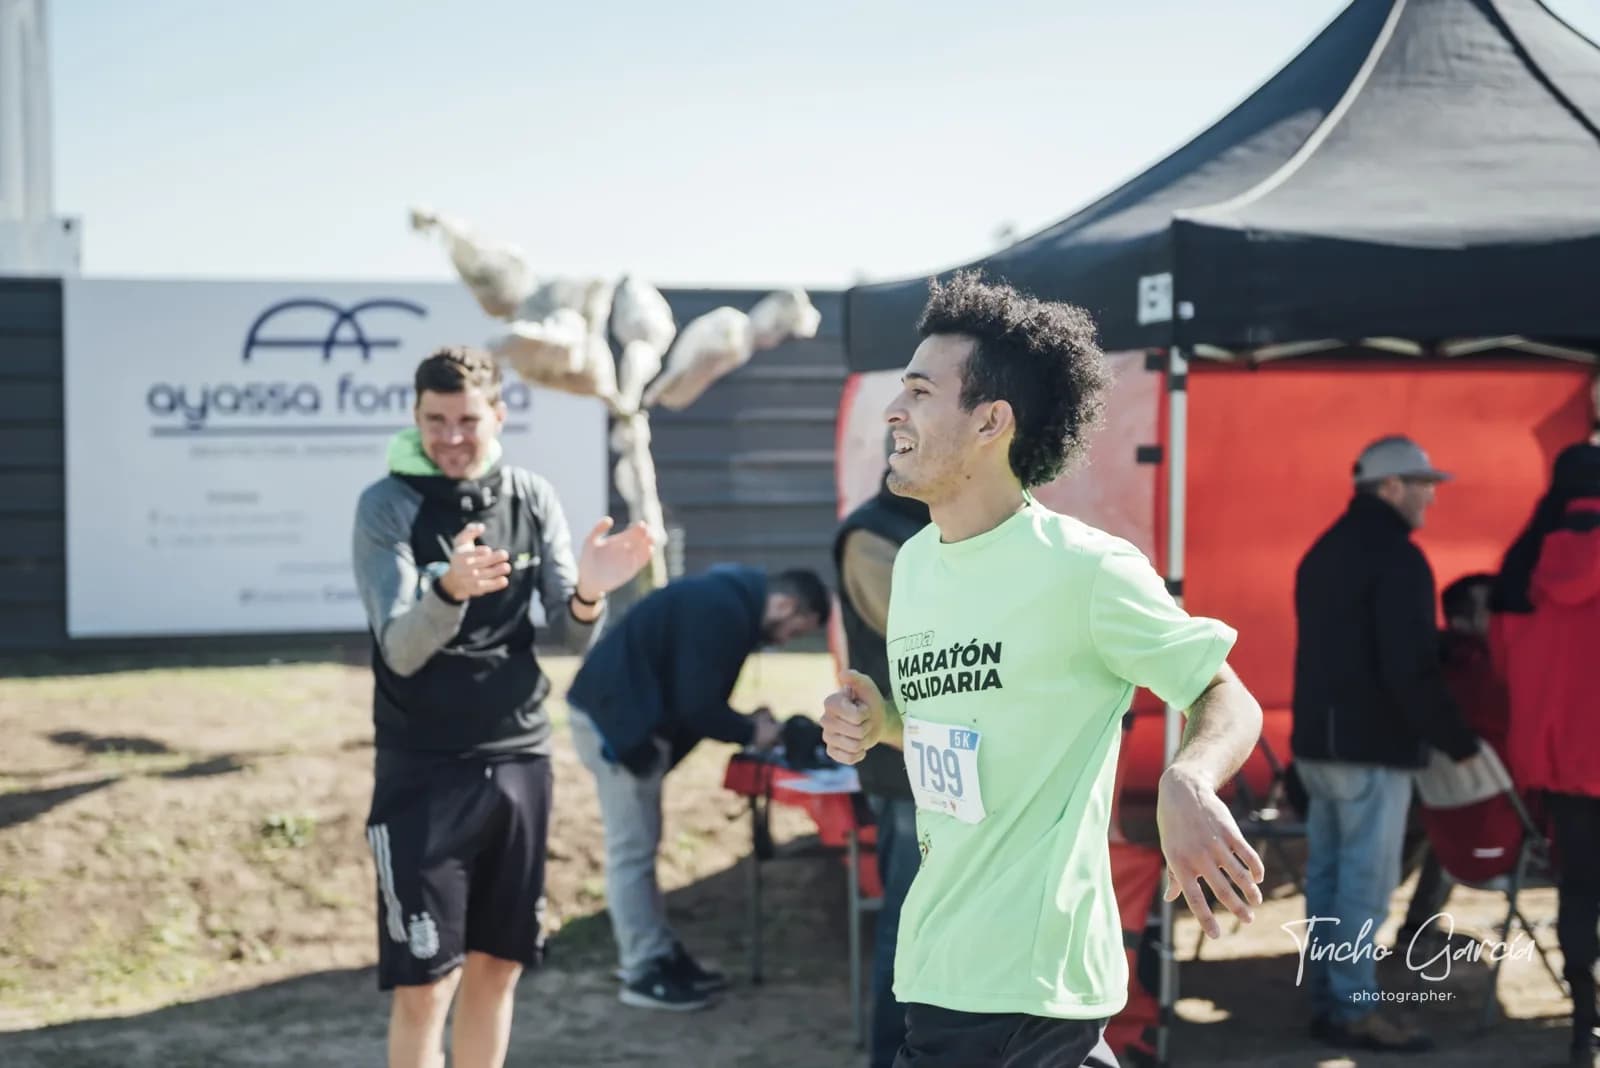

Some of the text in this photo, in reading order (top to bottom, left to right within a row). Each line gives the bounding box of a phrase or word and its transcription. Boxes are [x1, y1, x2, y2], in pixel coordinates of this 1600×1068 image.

[147, 382, 321, 430] ayassa
[897, 638, 1003, 681] MARATÓN
[900, 668, 1003, 702] SOLIDARIA
[911, 740, 964, 798] 799
